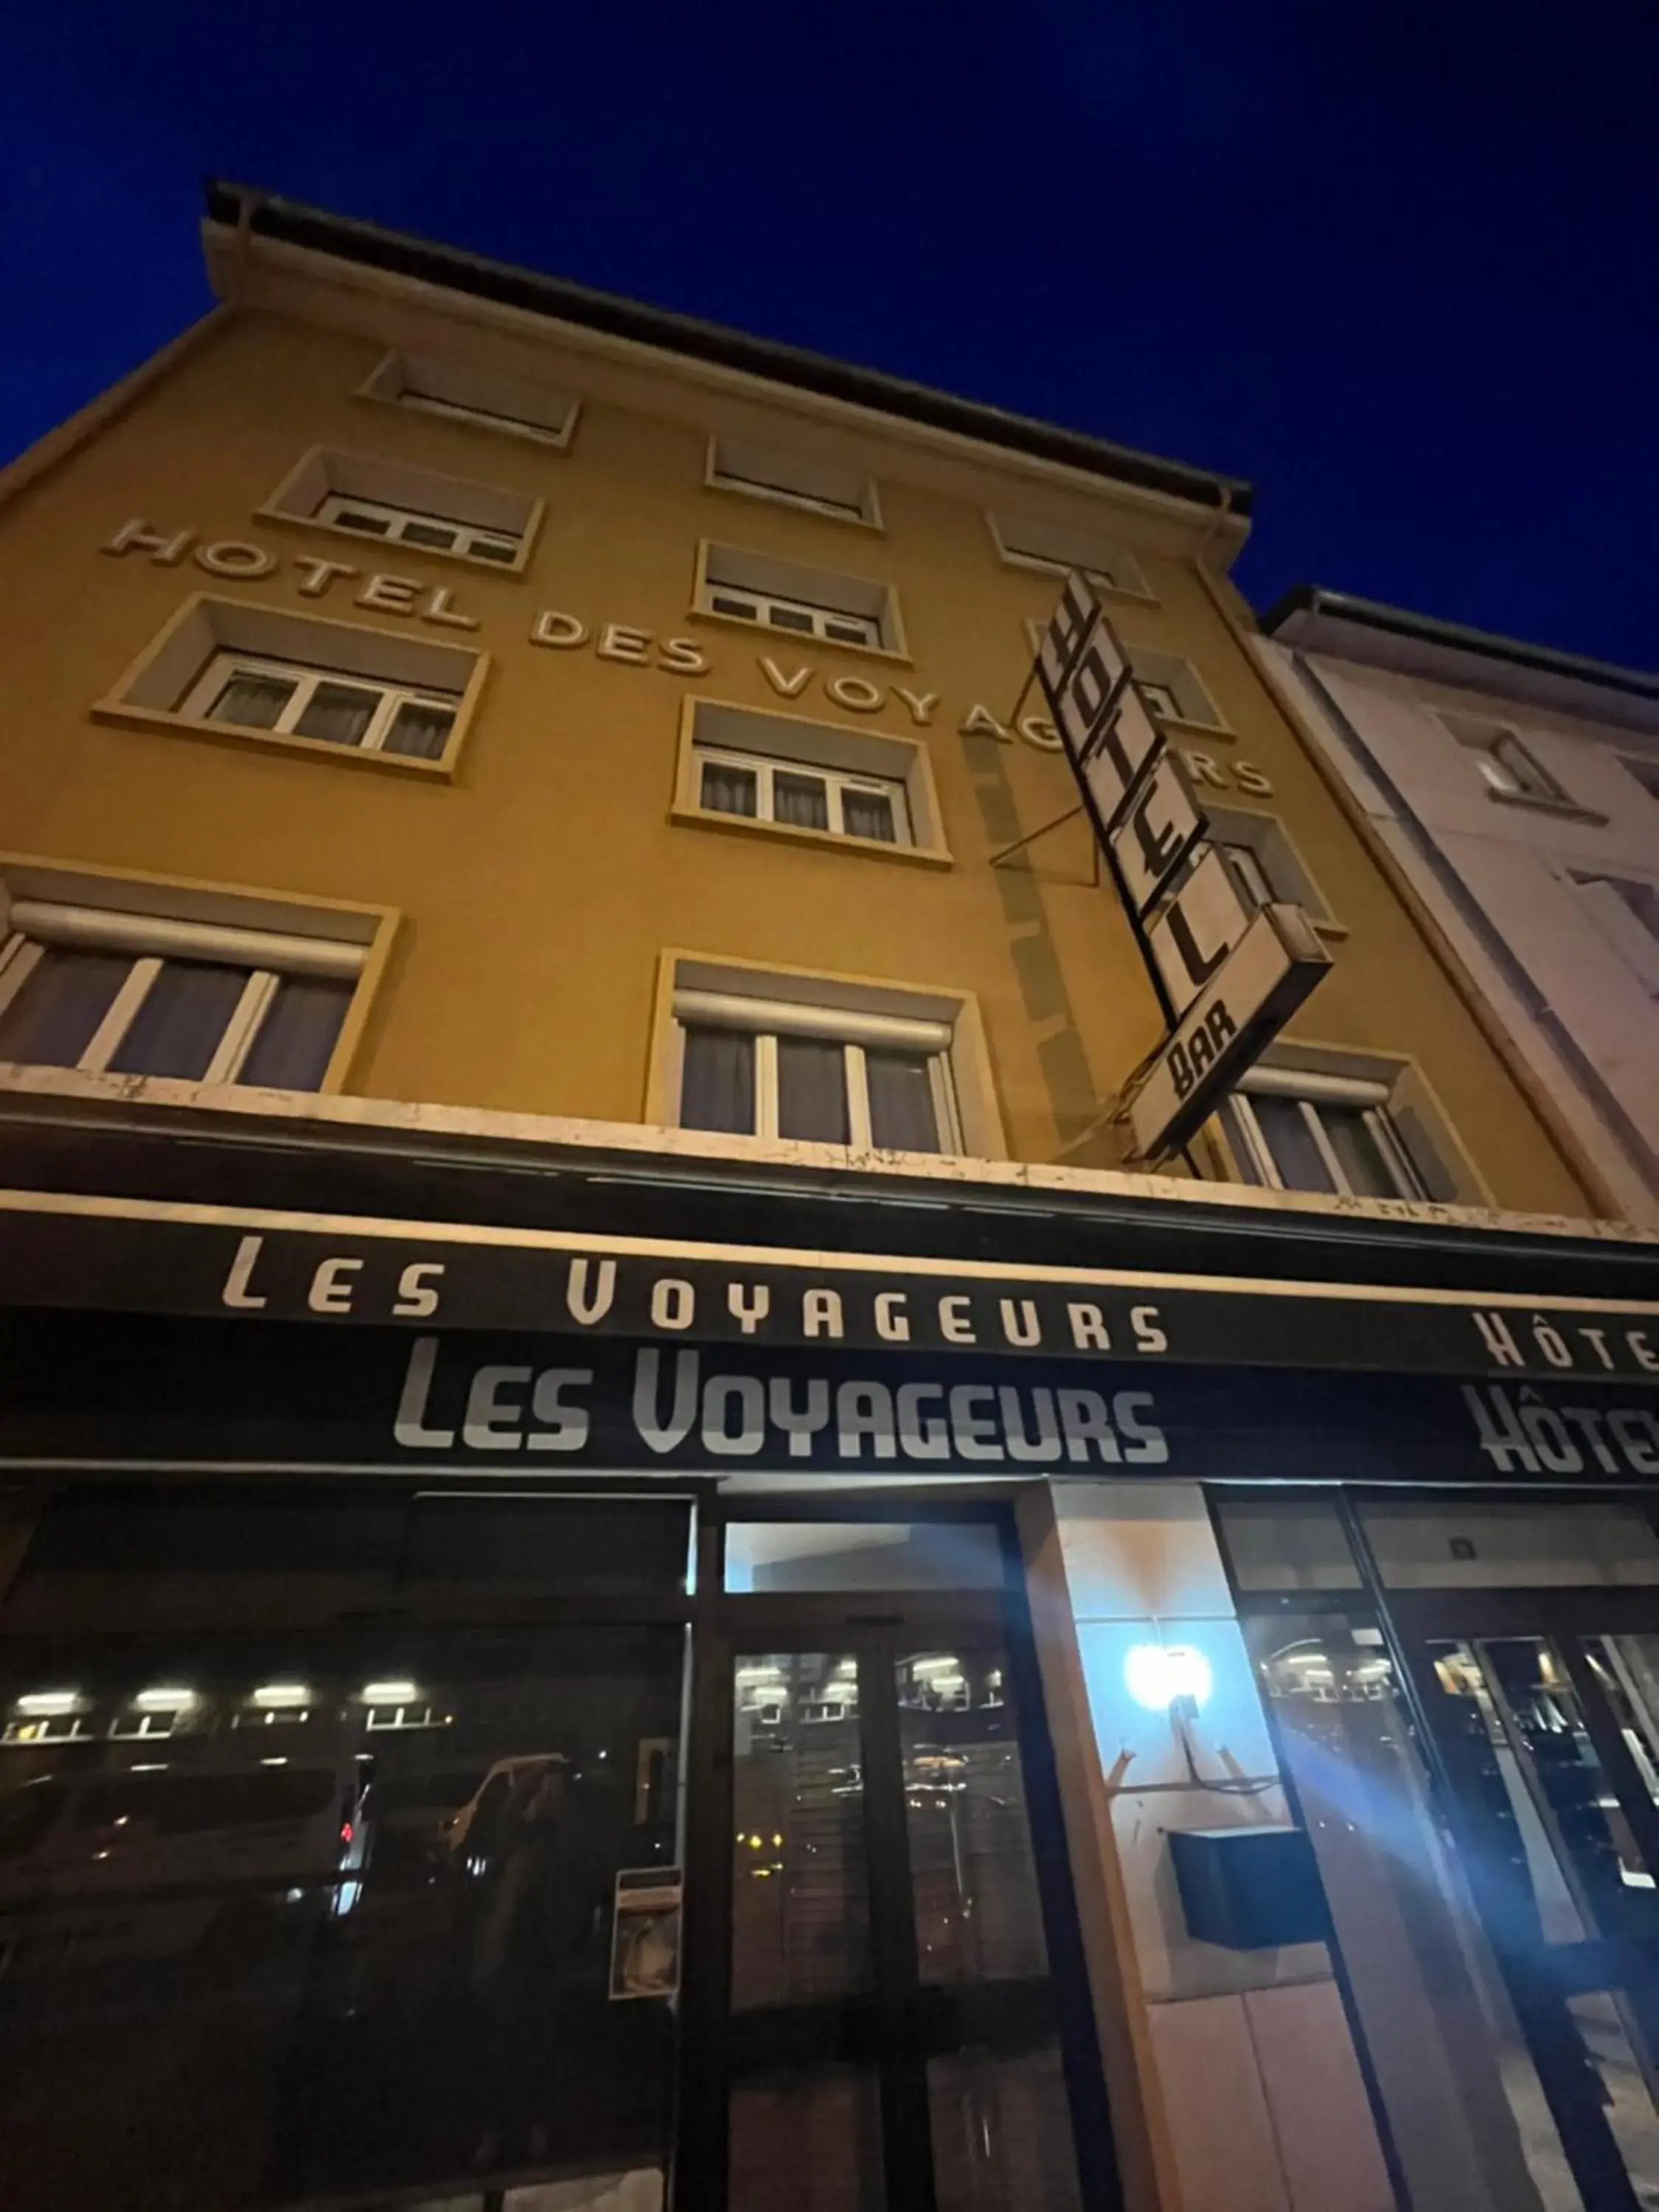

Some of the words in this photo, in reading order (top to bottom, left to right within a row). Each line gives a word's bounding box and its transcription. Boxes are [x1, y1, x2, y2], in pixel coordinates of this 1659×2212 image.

[102, 519, 479, 628] HOTEL
[530, 611, 710, 675] DES
[757, 657, 1273, 798] VOYAGRS
[1048, 578, 1229, 987] HOTEL
[1166, 999, 1238, 1099] BAR
[223, 1236, 445, 1316] LES
[566, 1258, 1168, 1352] VOYAGEURS
[394, 1337, 593, 1451] LES
[632, 1348, 1169, 1464] VOYAGEURS
[1459, 1384, 1659, 1473] HÔTE
